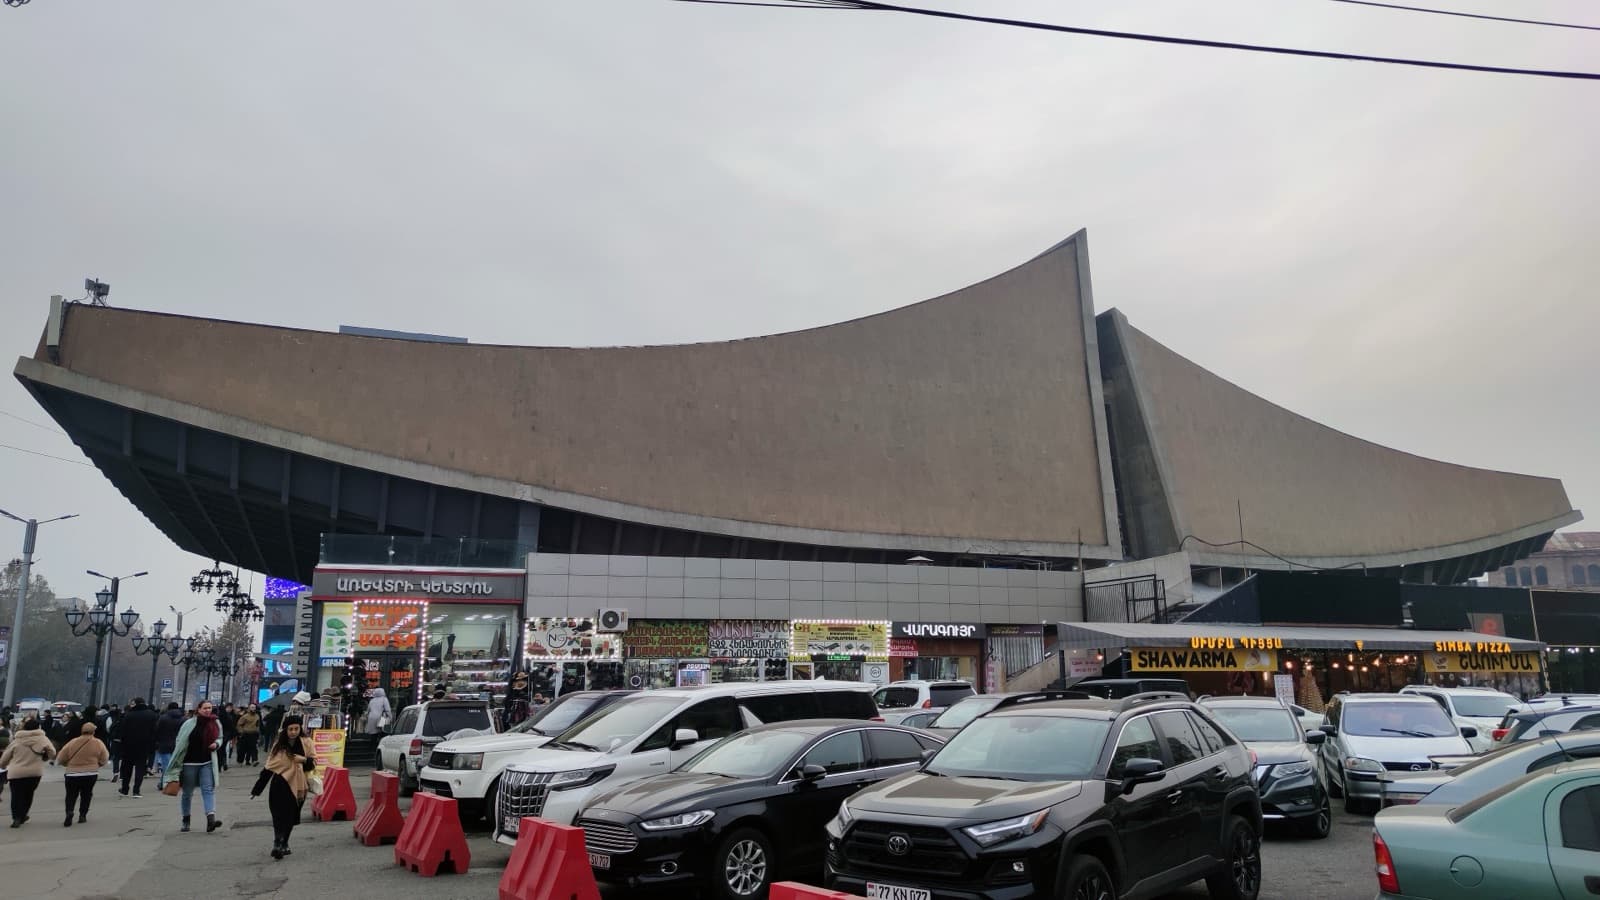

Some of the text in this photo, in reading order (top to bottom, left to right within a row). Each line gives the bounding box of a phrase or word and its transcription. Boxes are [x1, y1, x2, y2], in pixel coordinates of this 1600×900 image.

[337, 577, 493, 594] ԱՌԵՎՏՐԻ ԿԵՆՏՐՈՆ
[296, 596, 313, 675] TERRANOVA
[902, 624, 976, 637] ՎԱՐԱԳՈՒՅՐ
[1191, 637, 1235, 649] ՍԻՄԲԱ
[1435, 640, 1512, 653] SIMBA PIZZA
[1138, 650, 1237, 668] SHAWARMA
[1459, 654, 1533, 670] ՇԱՈՒՐՄԱ
[878, 886, 928, 900] 77 KN 077
